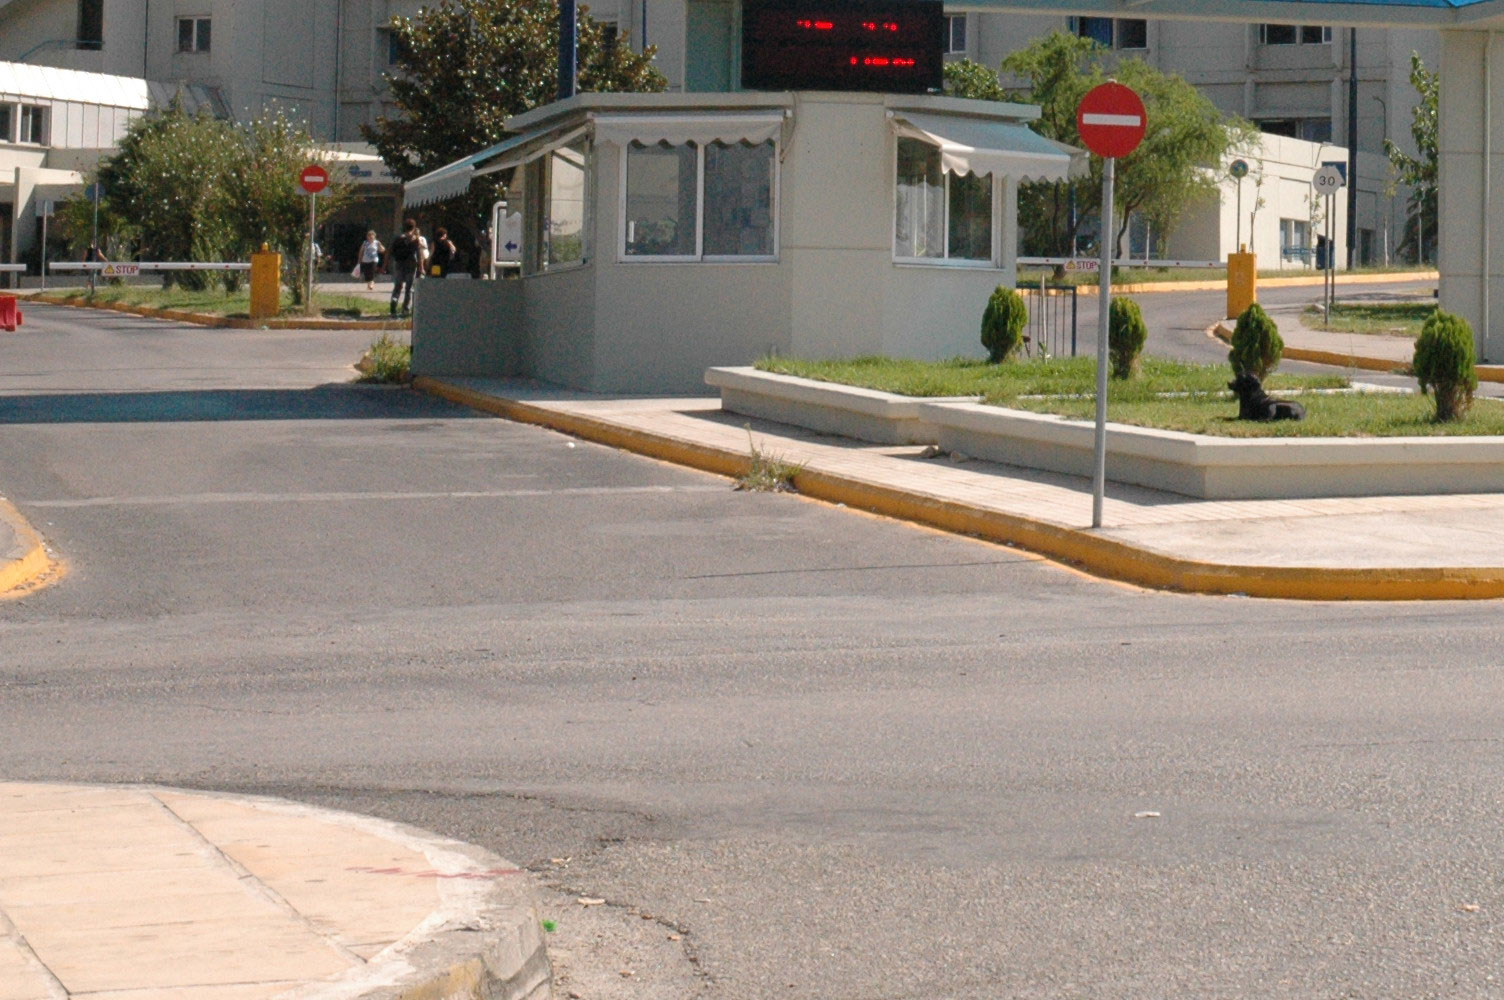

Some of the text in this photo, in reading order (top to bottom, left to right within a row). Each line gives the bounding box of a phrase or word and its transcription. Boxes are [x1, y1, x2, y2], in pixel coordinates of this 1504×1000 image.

[1319, 175, 1336, 187] 30
[115, 265, 138, 274] STOP
[1075, 260, 1098, 270] STOP
